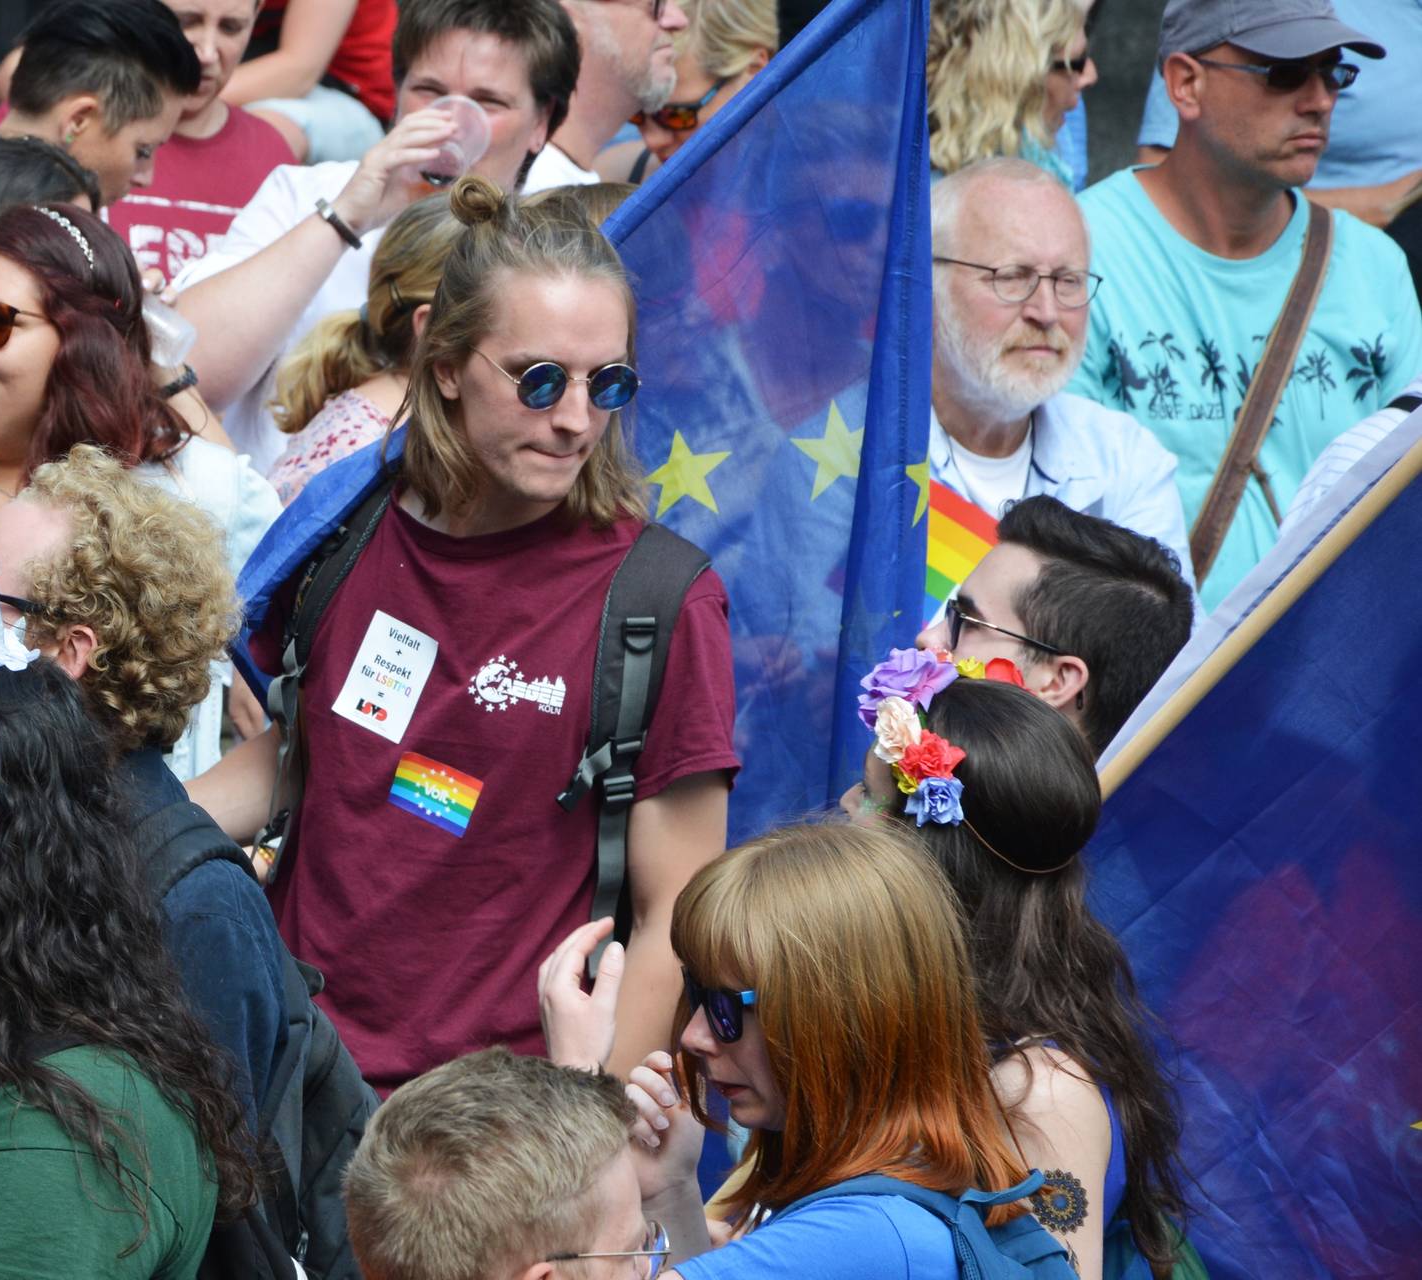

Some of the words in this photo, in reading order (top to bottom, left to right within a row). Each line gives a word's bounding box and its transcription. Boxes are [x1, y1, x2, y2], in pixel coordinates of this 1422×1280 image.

[389, 627, 421, 651] Vielfalt
[361, 665, 376, 679] für
[374, 654, 412, 680] Respekt
[424, 781, 450, 805] Volt
